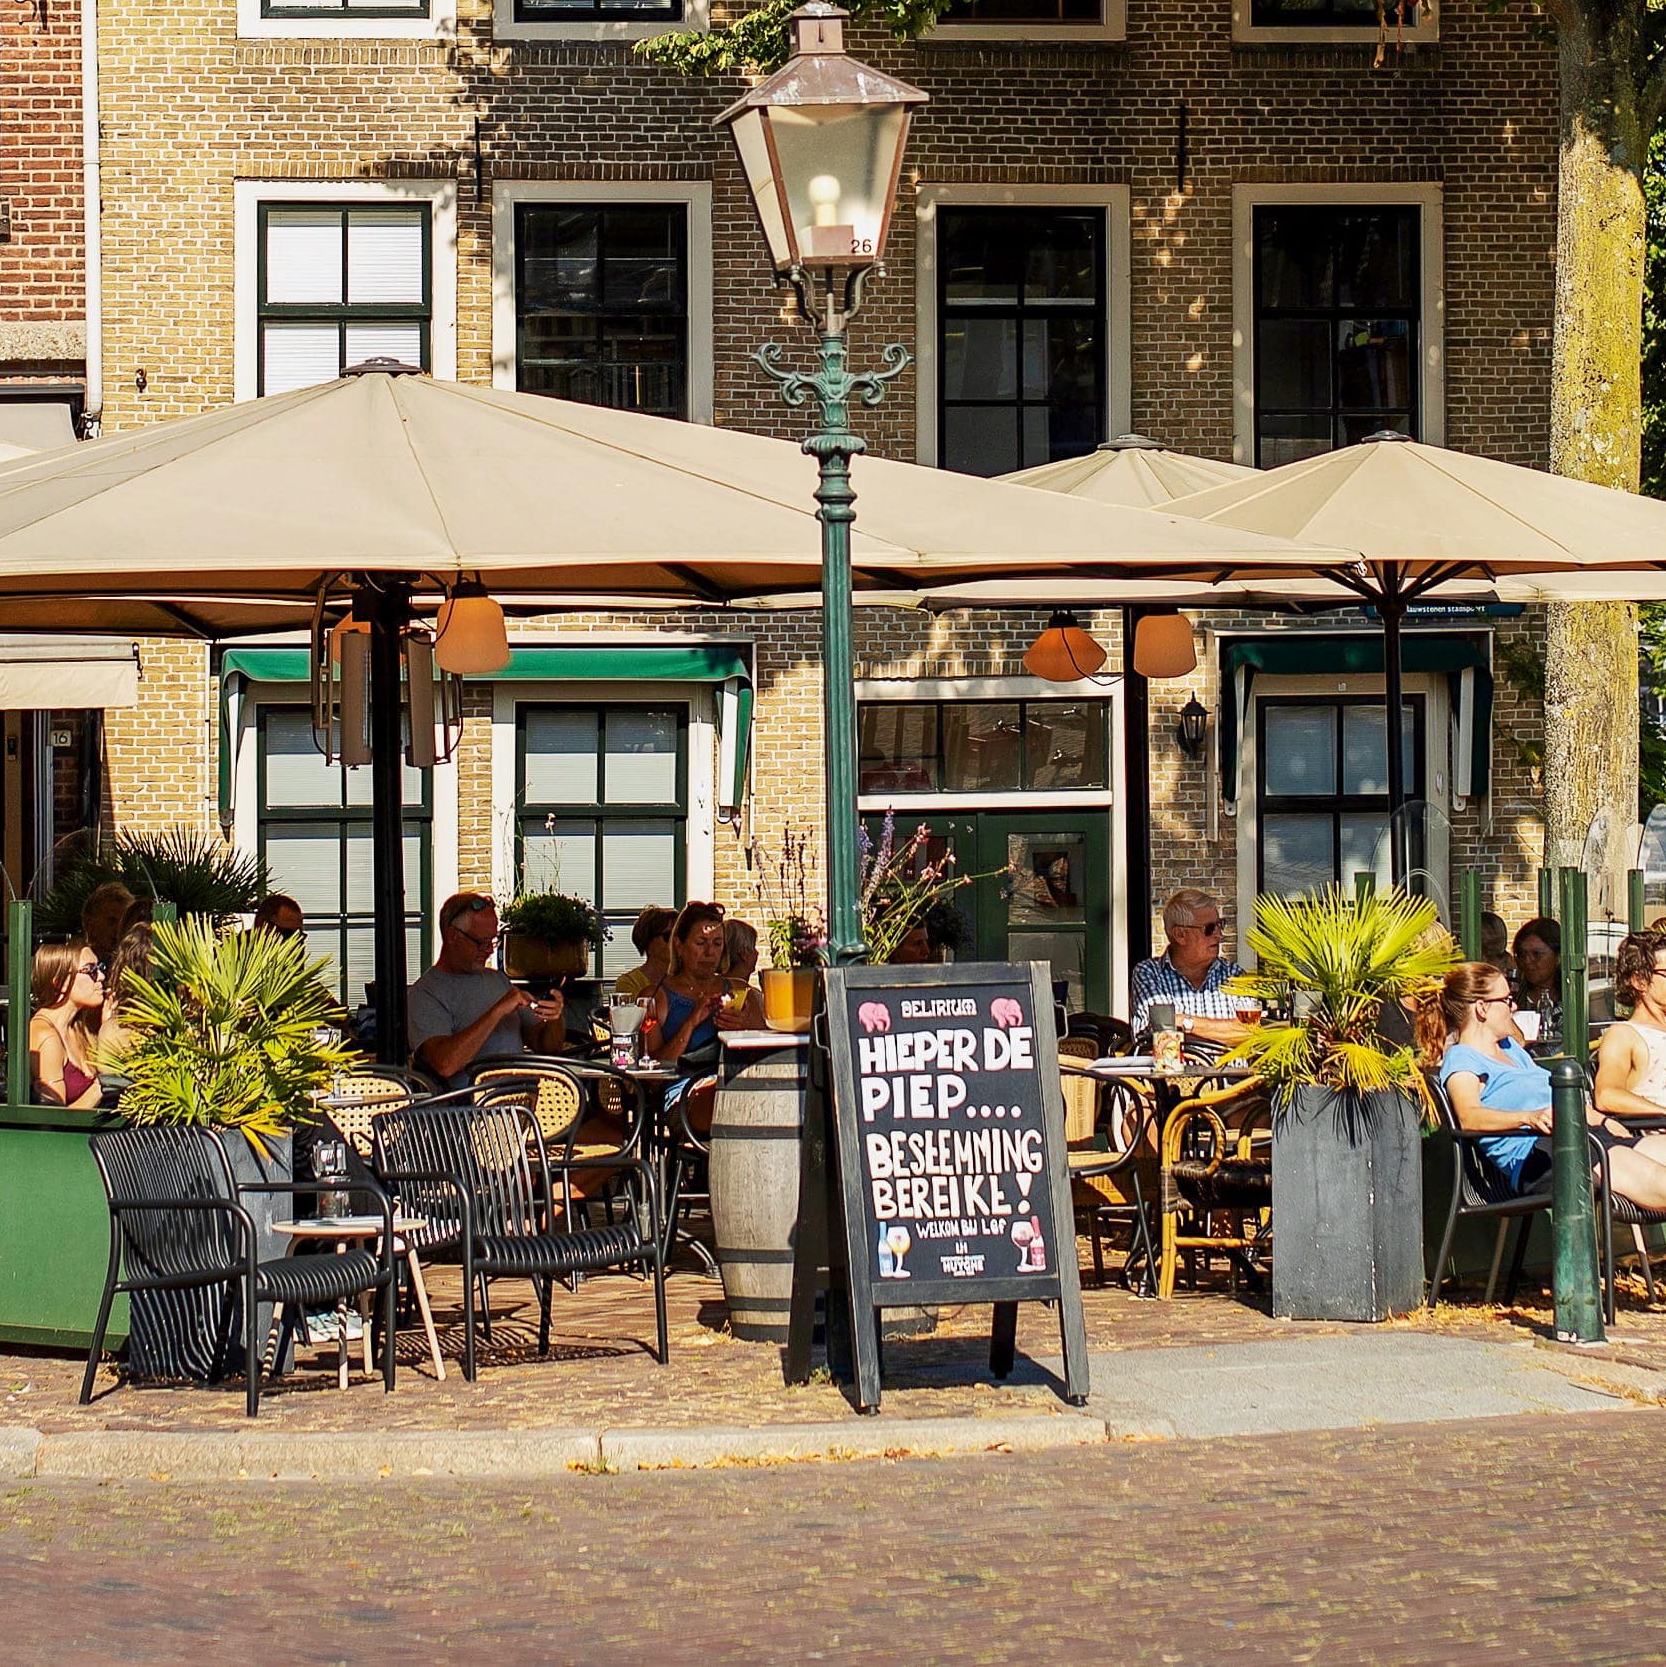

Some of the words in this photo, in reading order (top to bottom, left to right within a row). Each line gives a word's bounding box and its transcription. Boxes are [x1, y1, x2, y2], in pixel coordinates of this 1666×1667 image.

[851, 238, 872, 254] 26
[1406, 604, 1446, 614] lauwstenen
[52, 732, 68, 745] 16
[900, 998, 978, 1018] DELIRIUM
[858, 1028, 980, 1075] HIEPER
[983, 1025, 1035, 1071] DE
[860, 1074, 1023, 1123] PIEP....
[865, 1127, 1044, 1179] BESTEMMING
[915, 1220, 960, 1240] WELKOM
